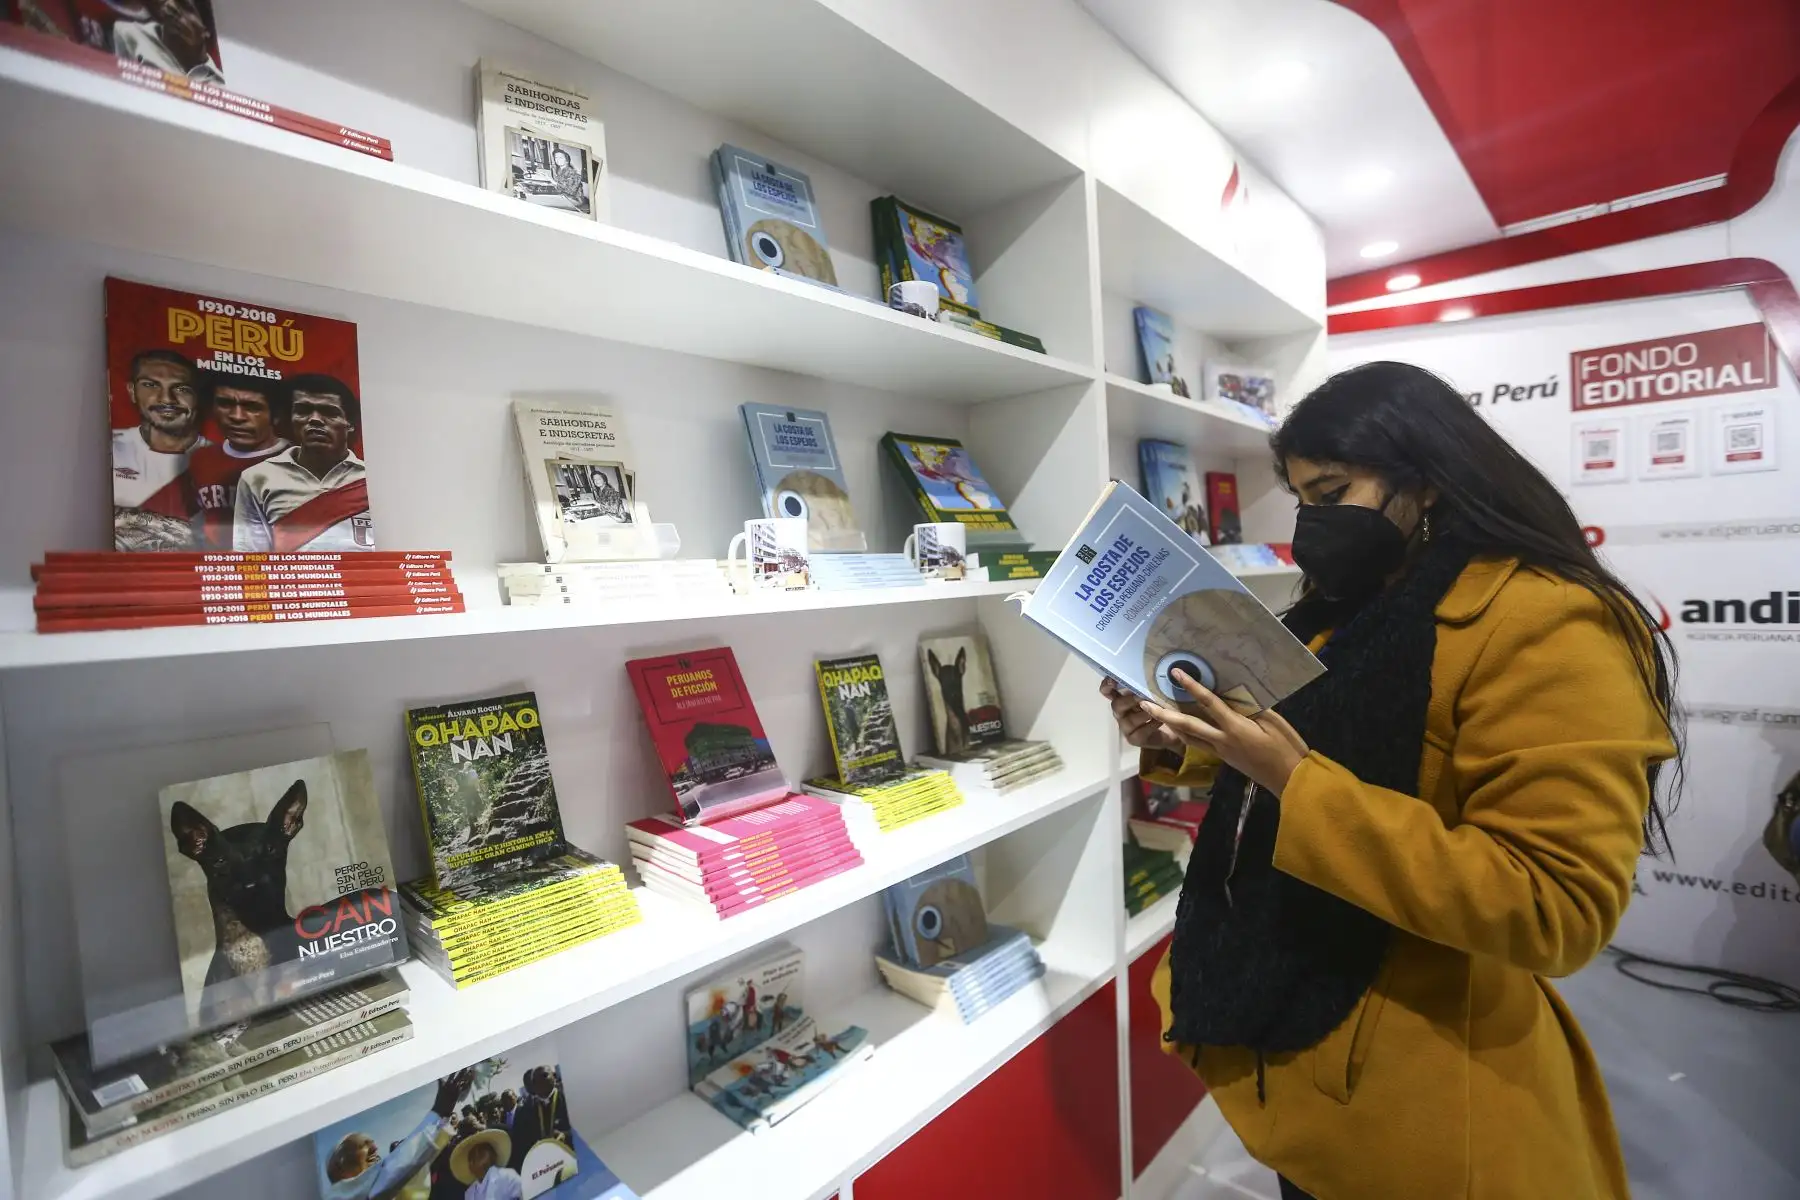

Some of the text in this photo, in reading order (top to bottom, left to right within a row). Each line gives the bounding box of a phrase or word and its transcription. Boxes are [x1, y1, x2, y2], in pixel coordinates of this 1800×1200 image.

[222, 90, 270, 112] MUNDIALES
[507, 83, 580, 110] SABIHONDAS
[225, 103, 274, 123] MUNDIALES
[504, 94, 512, 104] E
[514, 97, 588, 123] INDISCRETAS
[197, 300, 277, 324] 1930-2018
[167, 307, 304, 362] PERÚ
[196, 358, 282, 381] MUNDIALES
[214, 351, 265, 368] EN LOS
[1581, 342, 1698, 380] FONDO
[1491, 375, 1559, 403] Perú
[1583, 362, 1763, 405] EDITORIAL
[539, 429, 616, 441] E INDISCRETAS
[540, 418, 607, 429] SABIHONDAS
[1074, 583, 1095, 602] LA
[1086, 549, 1122, 587] COSTA
[1112, 533, 1134, 554] DE
[1089, 546, 1151, 614] LOS ESPEJOS
[1095, 599, 1125, 632] CRÓNICAS
[1119, 547, 1171, 603] PERUANO-CHILENAS
[201, 593, 243, 601] 1930-2018
[203, 605, 245, 613] 1930-2018
[302, 601, 348, 609] MUNDIALES
[206, 615, 248, 623] 1930-2018
[305, 610, 351, 618] MUNDIALES
[666, 669, 713, 686] PERUANOS
[822, 665, 883, 688] QHAPAQ
[671, 681, 718, 698] DE FICCIÓN
[477, 704, 503, 714] ROCHA
[415, 707, 540, 747] QHAPAQ
[969, 720, 1002, 734] NUESTRO
[450, 732, 514, 765] ÑAN
[485, 850, 505, 859] GRAN
[506, 842, 535, 853] CAMINO
[536, 836, 553, 846] INCA
[335, 861, 368, 877] PERRO
[336, 866, 383, 885] SIN PELO
[338, 875, 385, 895] DEL PERÚ
[294, 885, 393, 939] CAN
[298, 918, 397, 962] NUESTRO
[340, 950, 354, 959] Elsa
[227, 1062, 243, 1072] SIN
[244, 1053, 264, 1066] PELO
[266, 1047, 281, 1056] DEL
[368, 1004, 388, 1015] Editora
[218, 1096, 235, 1106] SIN
[237, 1088, 258, 1101] PELO
[260, 1083, 275, 1092] DEL
[370, 1040, 391, 1050] Editora
